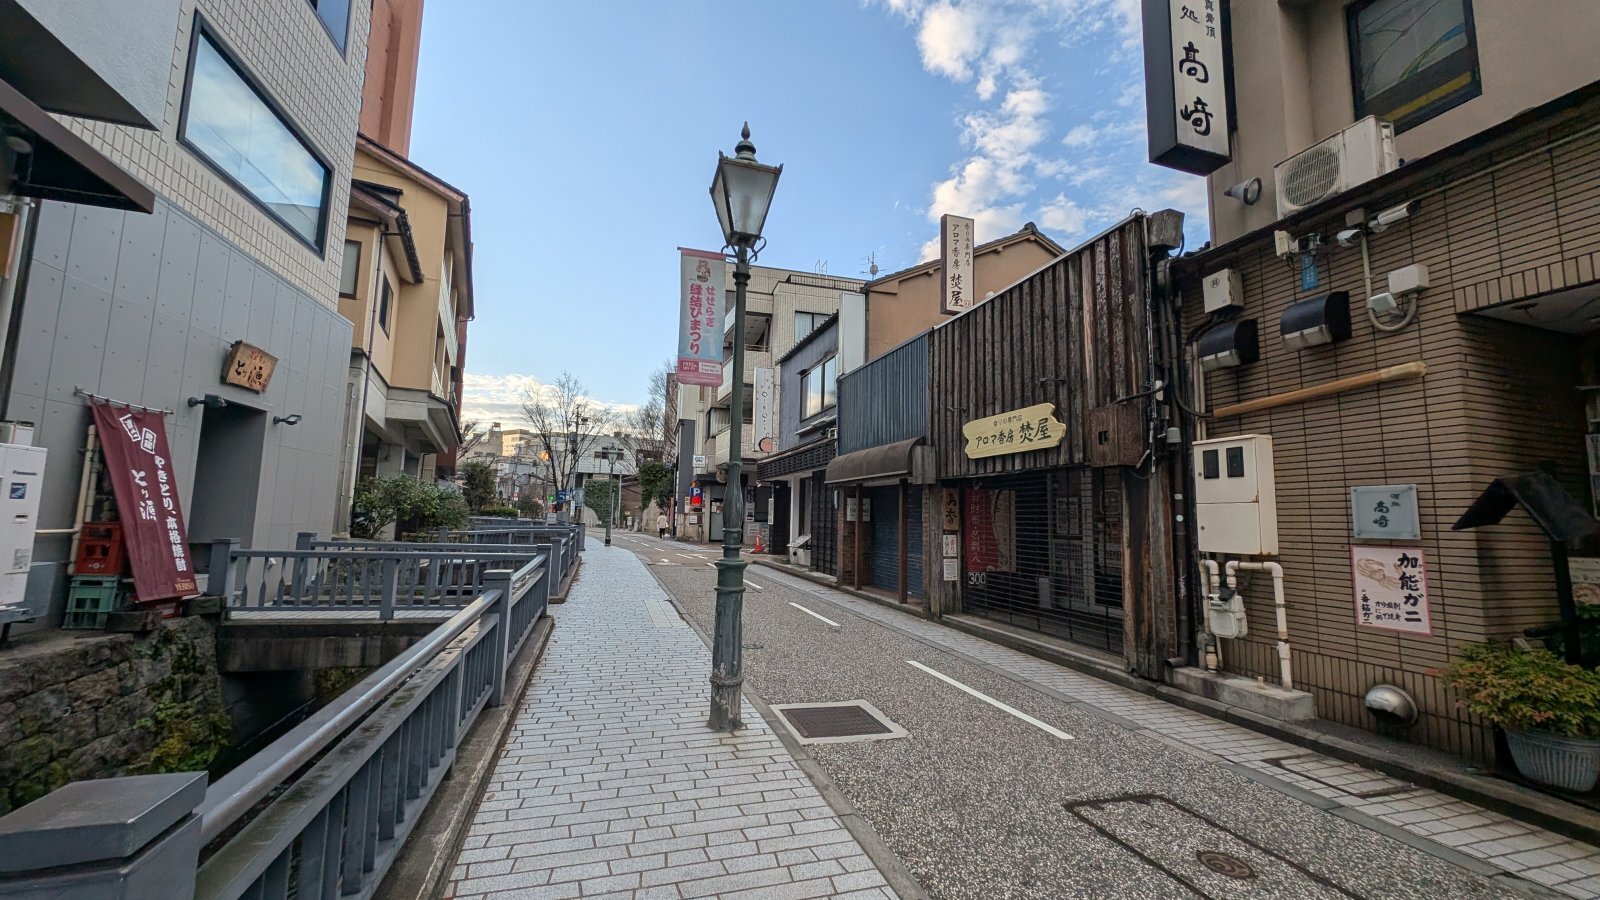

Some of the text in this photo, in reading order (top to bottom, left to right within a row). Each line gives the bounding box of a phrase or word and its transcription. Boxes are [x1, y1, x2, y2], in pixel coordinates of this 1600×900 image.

[963, 222, 971, 267] 香りの専門店
[688, 283, 703, 355] 縁結びまつり
[993, 415, 1023, 427] 香りの専門店
[131, 469, 157, 521] とり源
[693, 487, 701, 496] P
[1397, 552, 1425, 623] 加能ガニ
